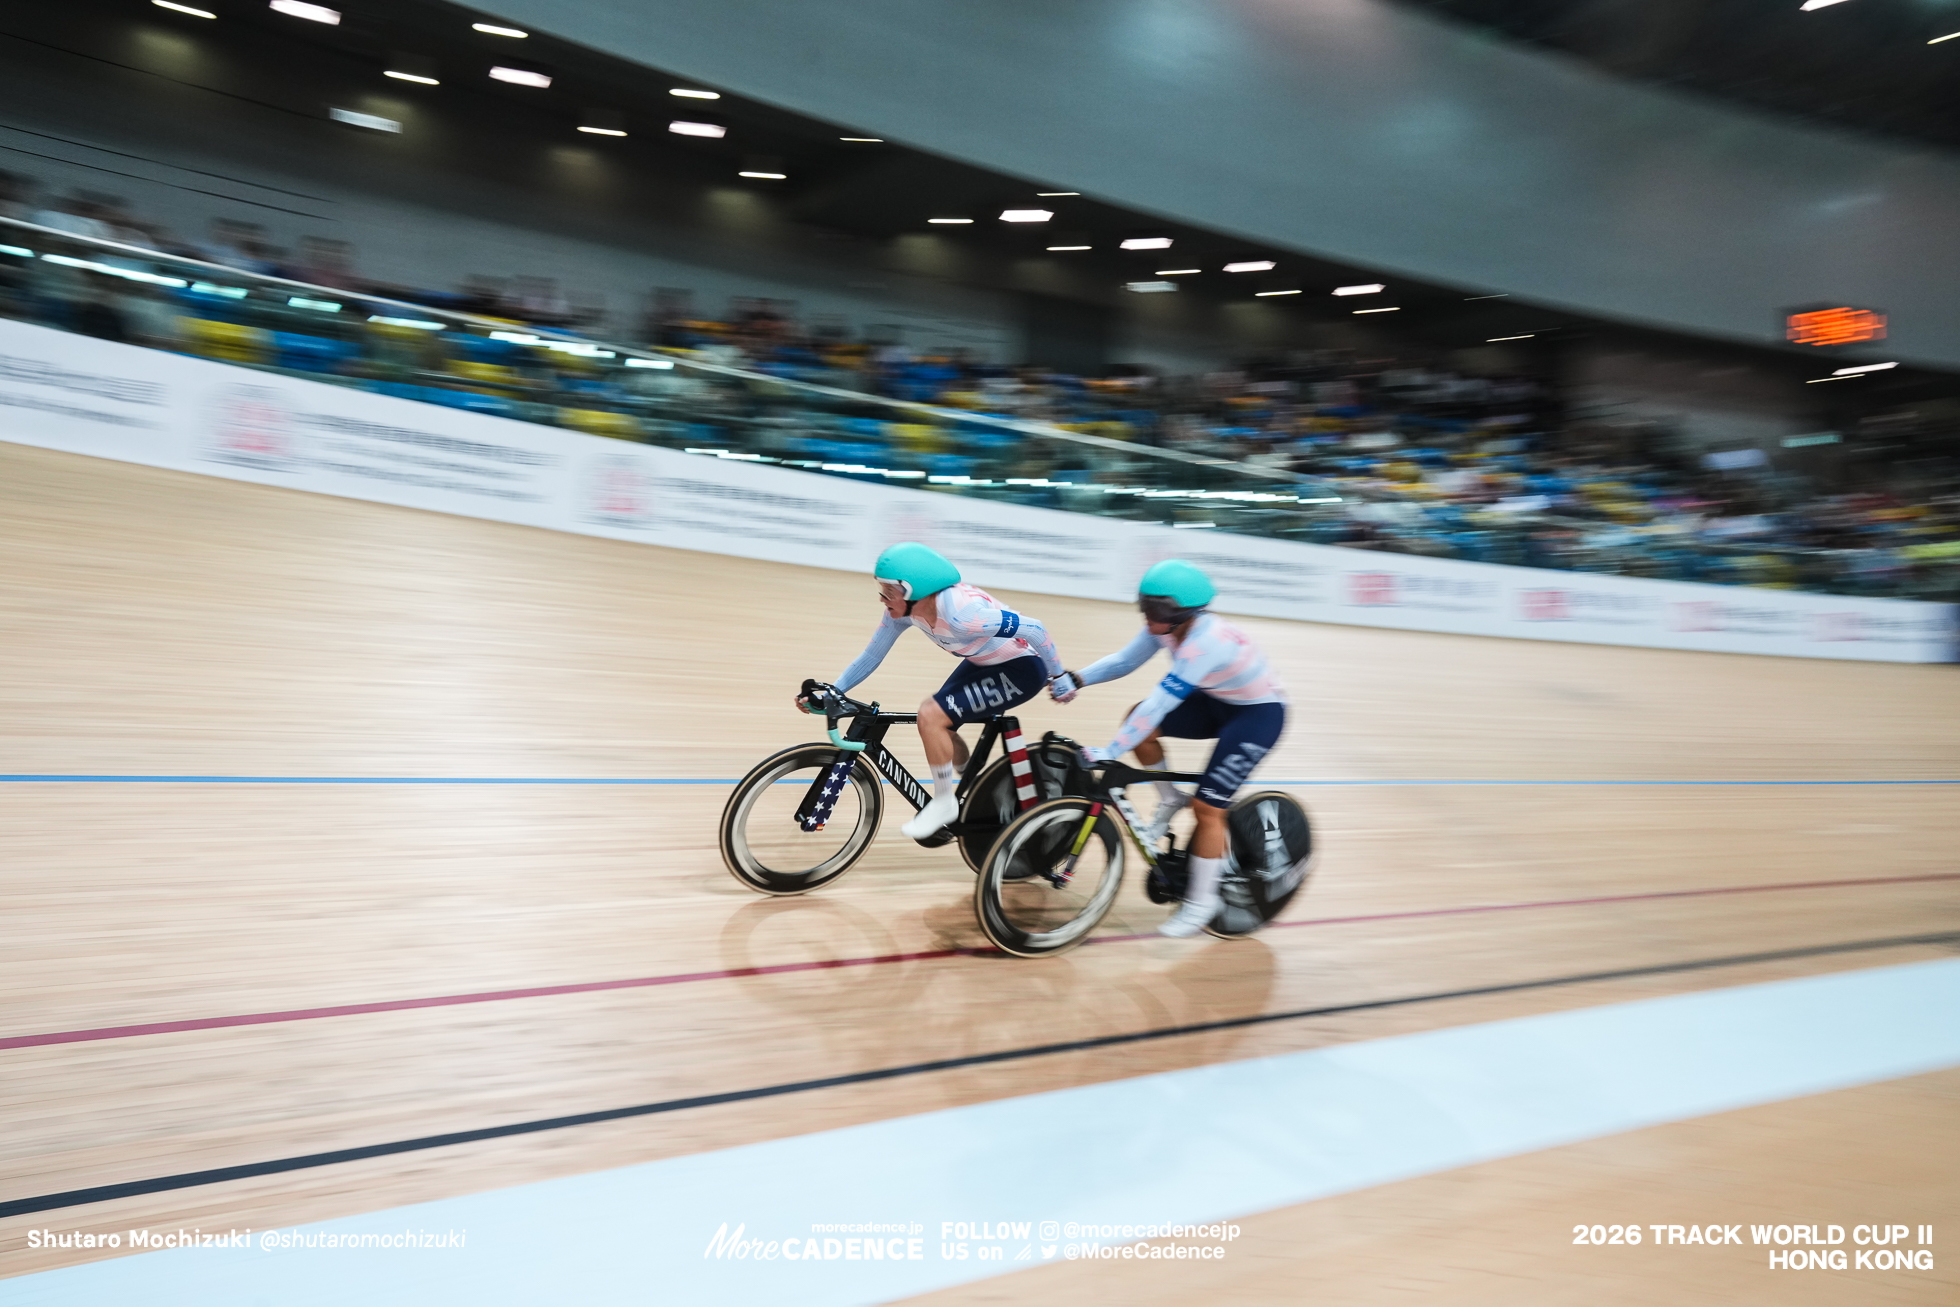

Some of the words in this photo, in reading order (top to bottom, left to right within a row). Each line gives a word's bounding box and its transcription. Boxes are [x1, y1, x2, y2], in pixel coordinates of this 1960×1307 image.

[963, 672, 1024, 713] USA
[878, 750, 926, 809] CANYON
[1208, 741, 1270, 791] USA
